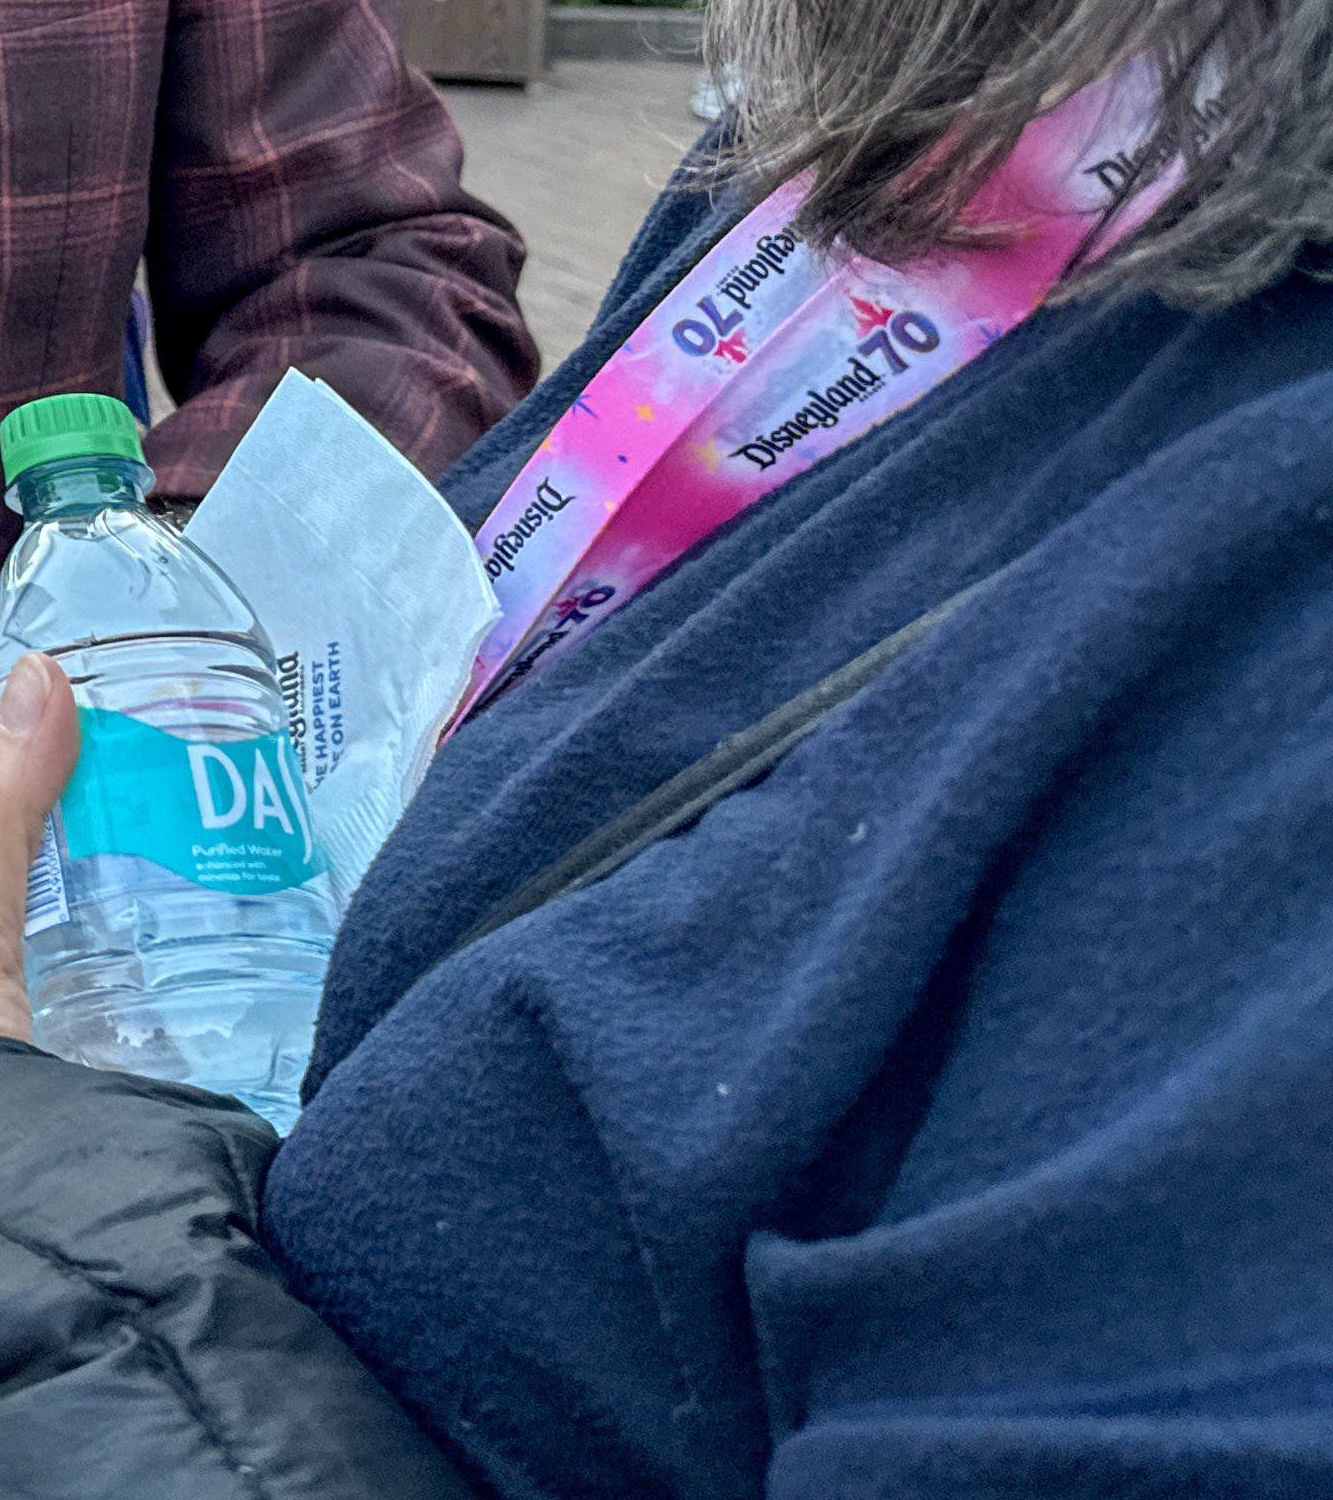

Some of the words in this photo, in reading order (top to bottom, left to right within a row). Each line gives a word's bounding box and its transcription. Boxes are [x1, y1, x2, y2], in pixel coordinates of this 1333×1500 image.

[672, 296, 744, 357] 70
[728, 357, 882, 471] Disneyland
[856, 310, 941, 375] 70
[483, 476, 576, 584] Disneyla
[327, 641, 341, 710] EARTH
[311, 661, 327, 759] HAPPIEST
[330, 714, 344, 746] ON
[312, 763, 328, 790] HE
[192, 843, 245, 857] Purified
[247, 844, 283, 857] Water
